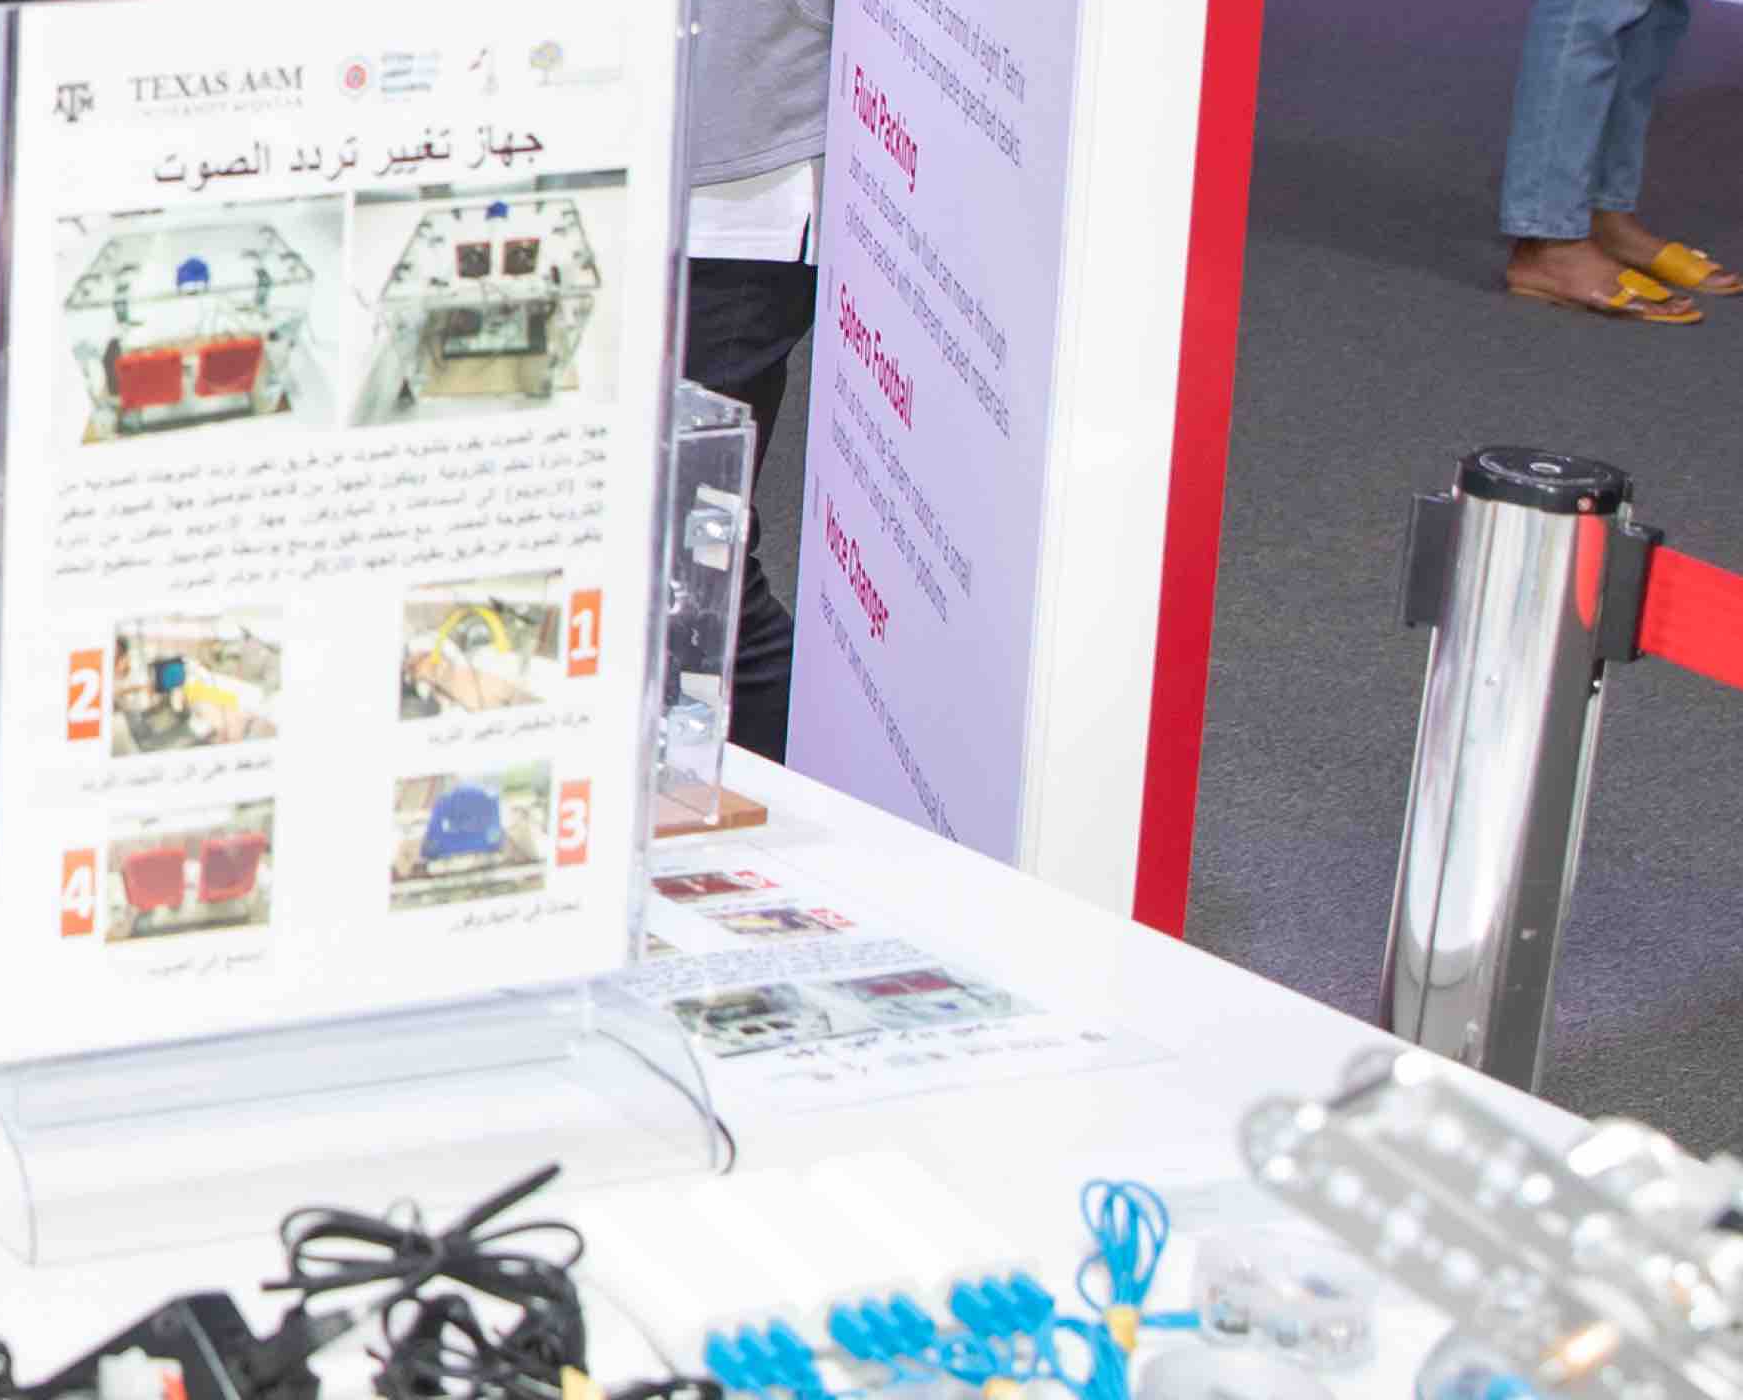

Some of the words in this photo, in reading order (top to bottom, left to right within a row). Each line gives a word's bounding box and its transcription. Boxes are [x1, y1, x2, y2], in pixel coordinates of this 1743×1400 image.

[128, 71, 229, 105] TEXAS
[373, 126, 452, 178] تغيير
[468, 122, 546, 171] جهاز
[852, 63, 879, 136] Fluid
[877, 92, 918, 194] Packing
[153, 143, 271, 192] الصوت
[289, 136, 360, 184] تردد
[838, 282, 872, 369] Sphero
[871, 329, 914, 431] Football
[826, 493, 849, 574] Voice
[848, 537, 890, 643] Changer
[570, 610, 598, 660] 1
[69, 669, 102, 722] 2
[556, 800, 587, 849] 3
[63, 866, 95, 917] 4
